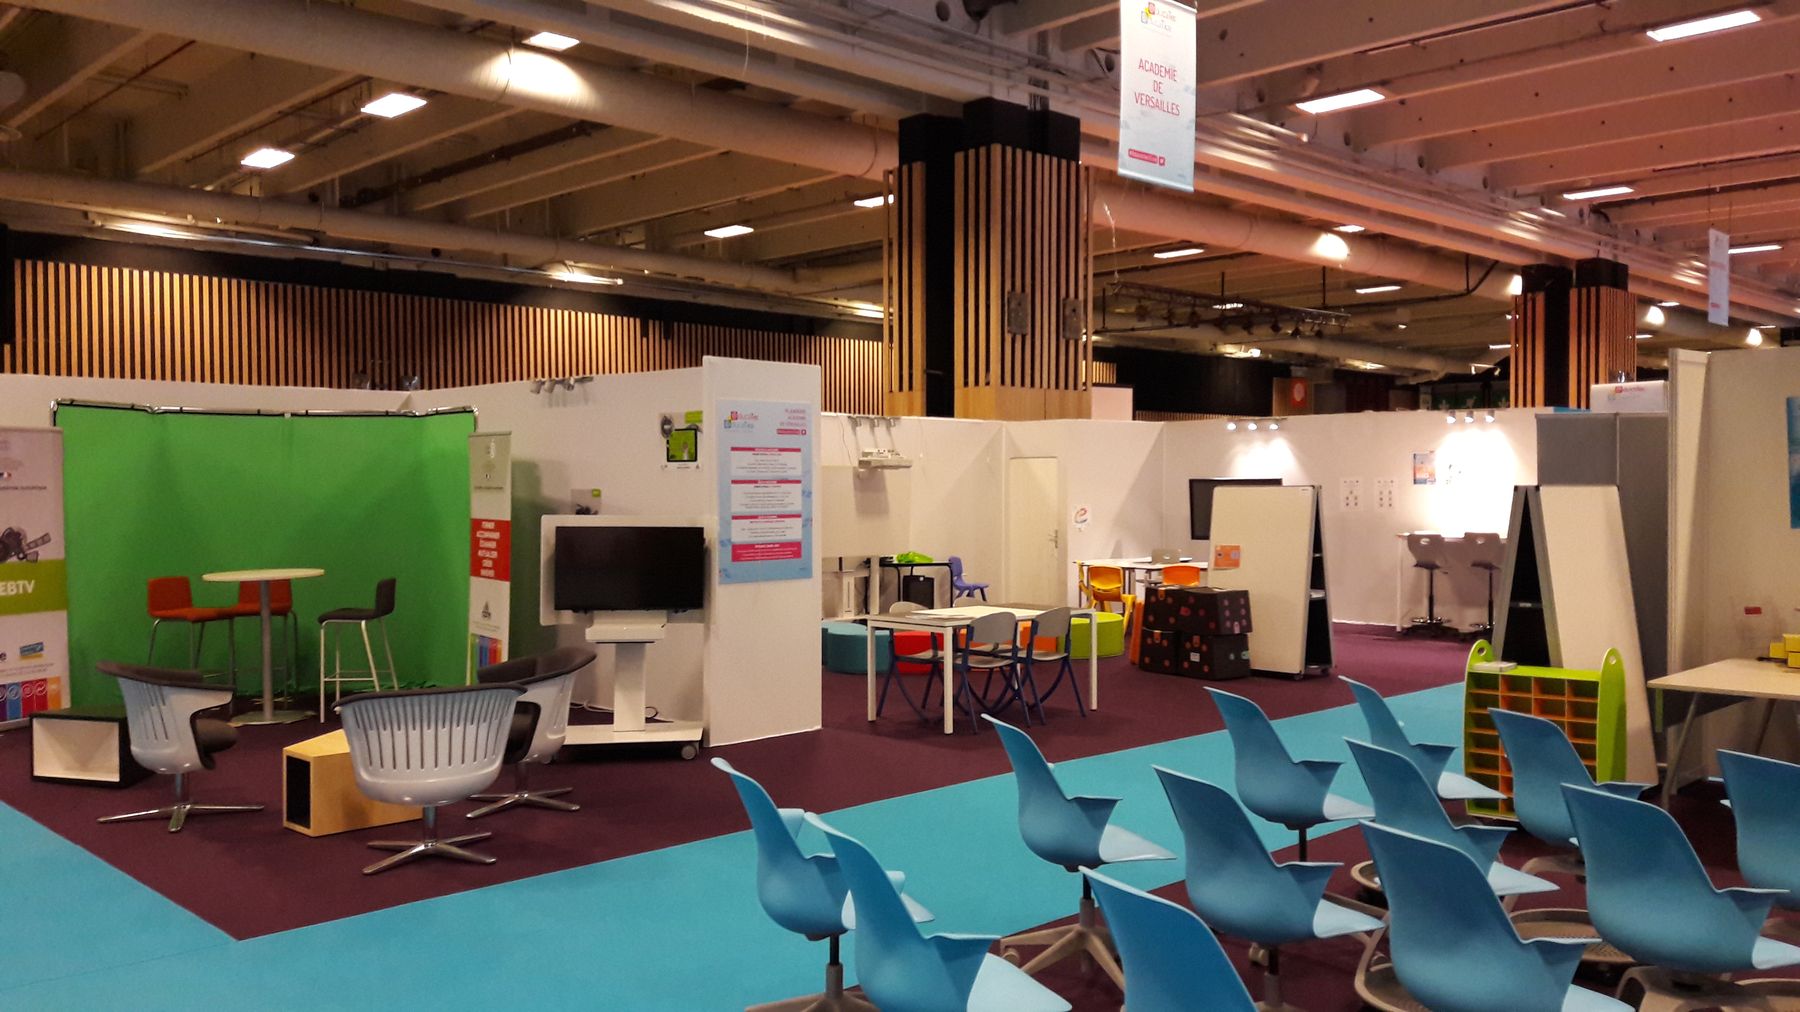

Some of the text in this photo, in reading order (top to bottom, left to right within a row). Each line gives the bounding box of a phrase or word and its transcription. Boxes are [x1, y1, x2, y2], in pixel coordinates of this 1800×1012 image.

[1138, 57, 1178, 82] ACADEMIE
[1153, 80, 1163, 94] DE
[1134, 91, 1180, 116] VERSAILLES
